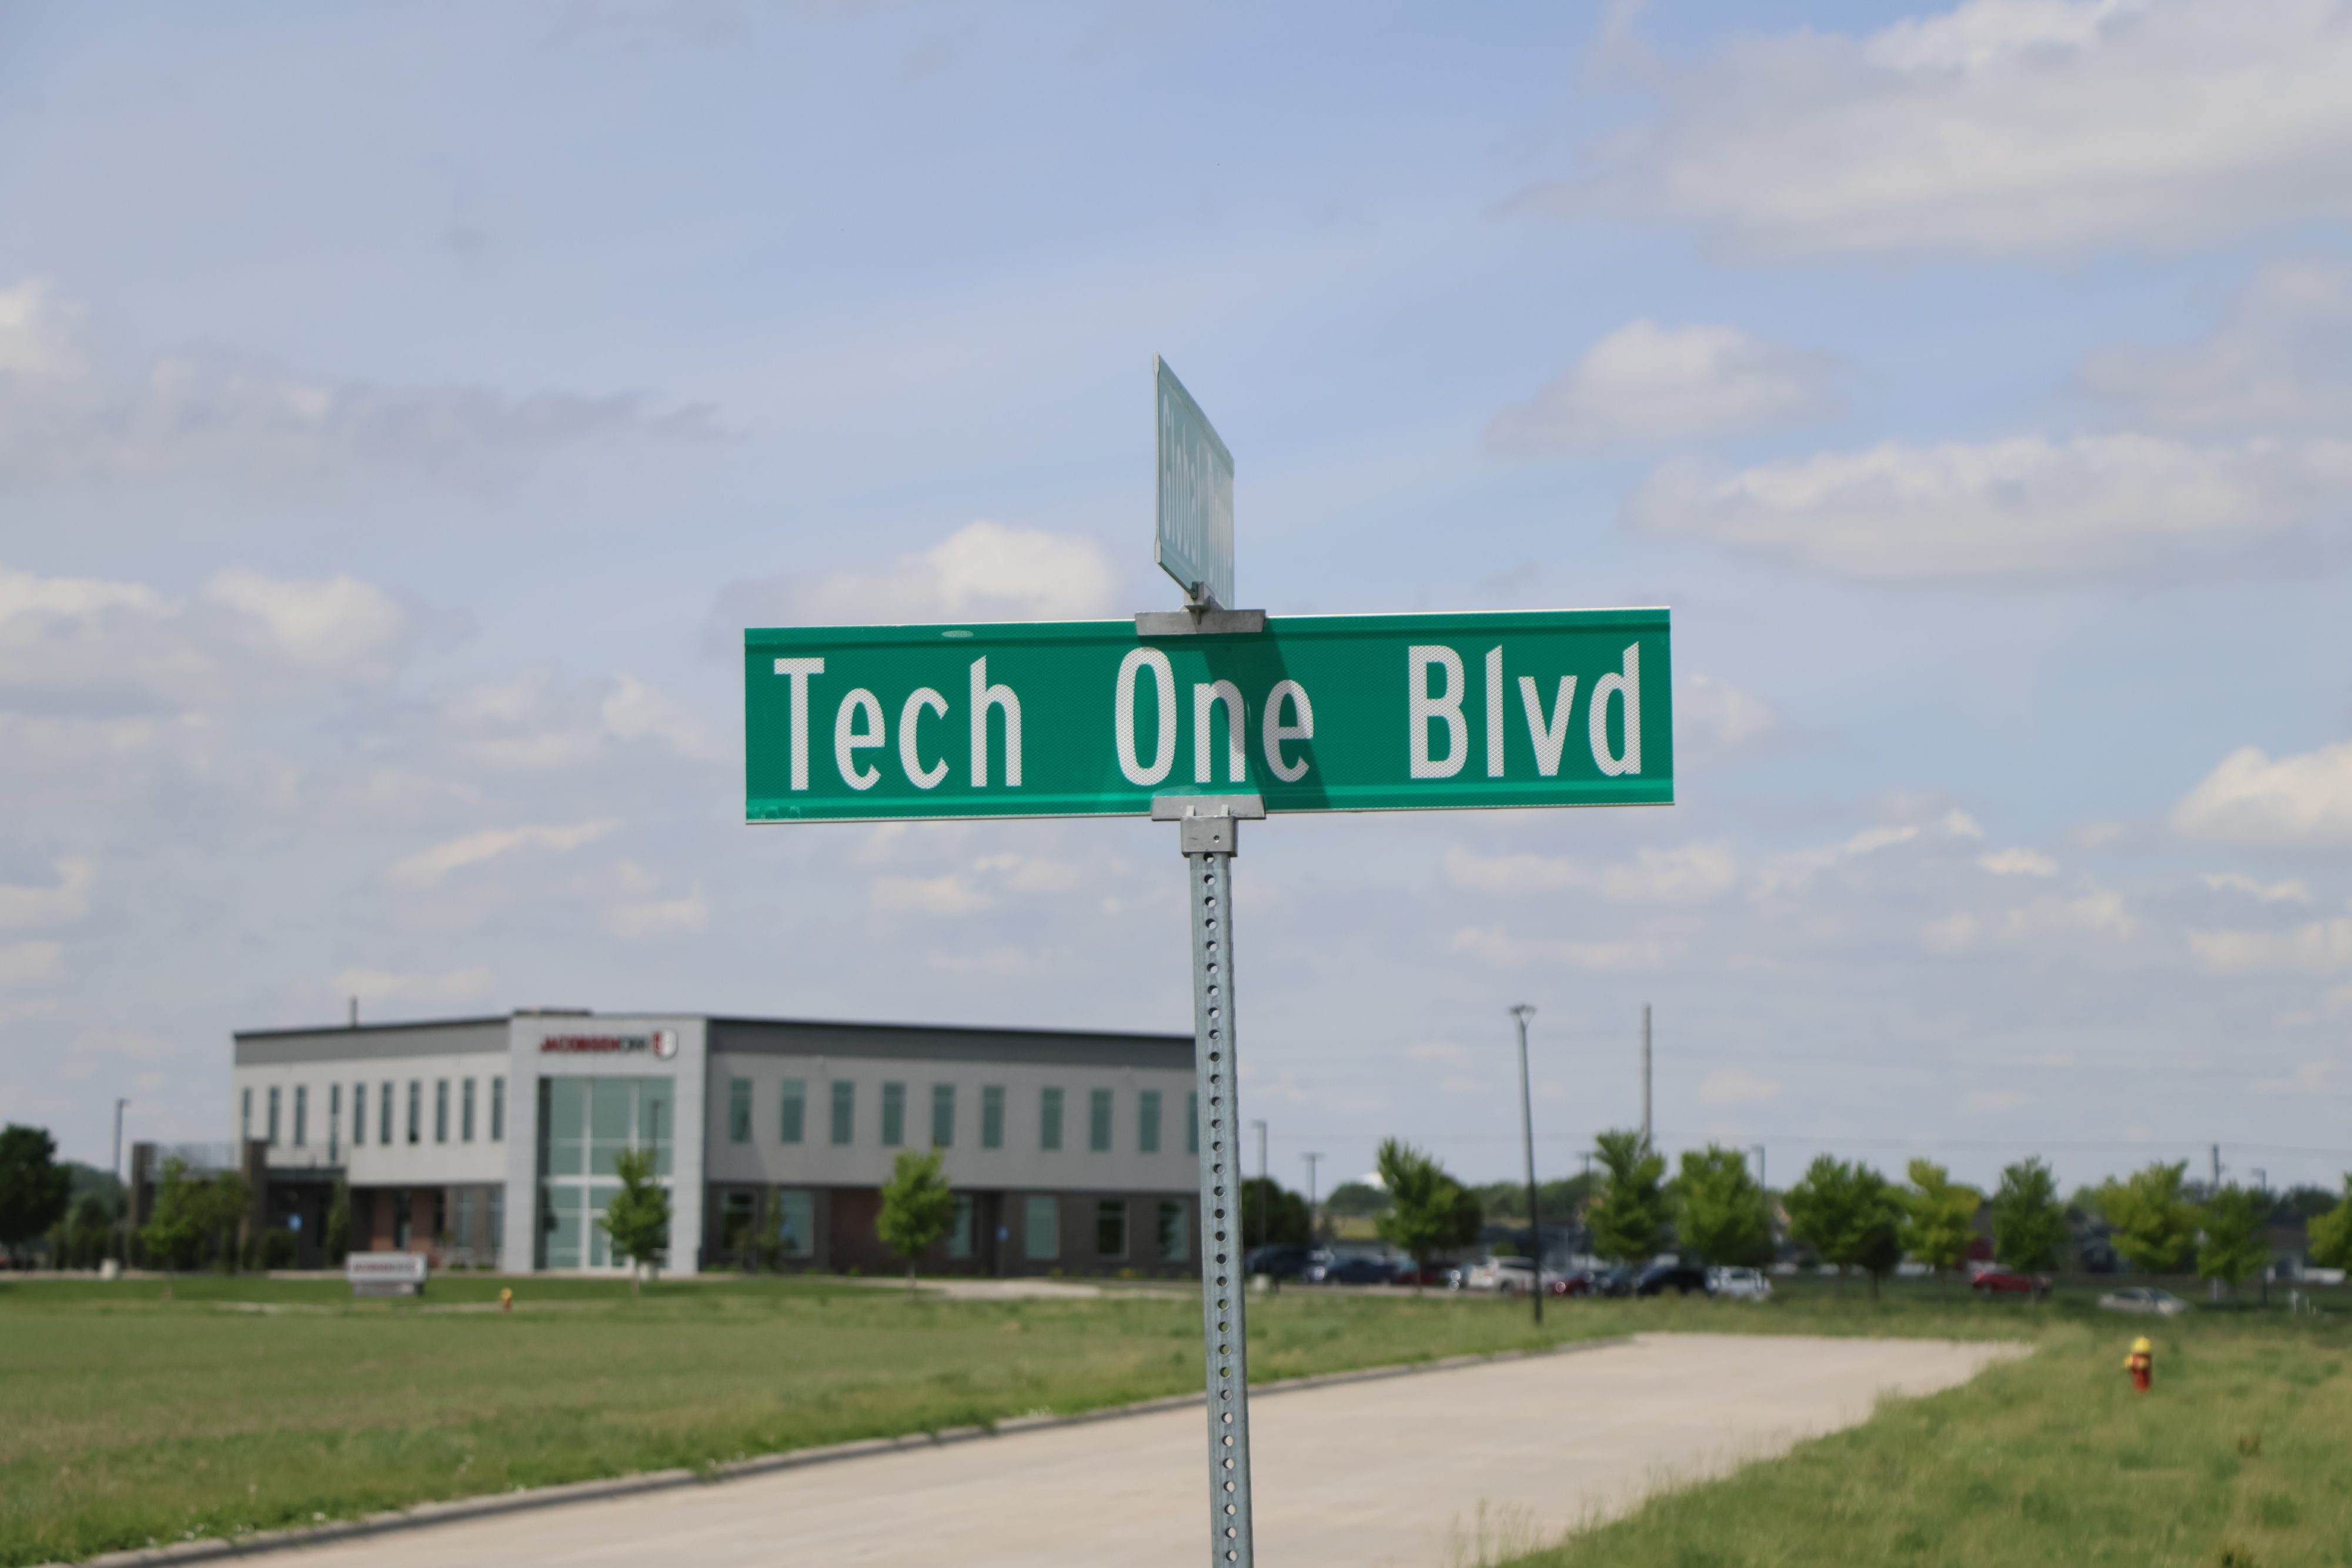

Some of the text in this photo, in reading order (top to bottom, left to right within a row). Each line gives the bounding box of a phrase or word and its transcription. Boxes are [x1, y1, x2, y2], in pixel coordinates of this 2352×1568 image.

[1163, 393, 1232, 608] Global Drive
[774, 641, 1642, 790] Tech One Blvd
